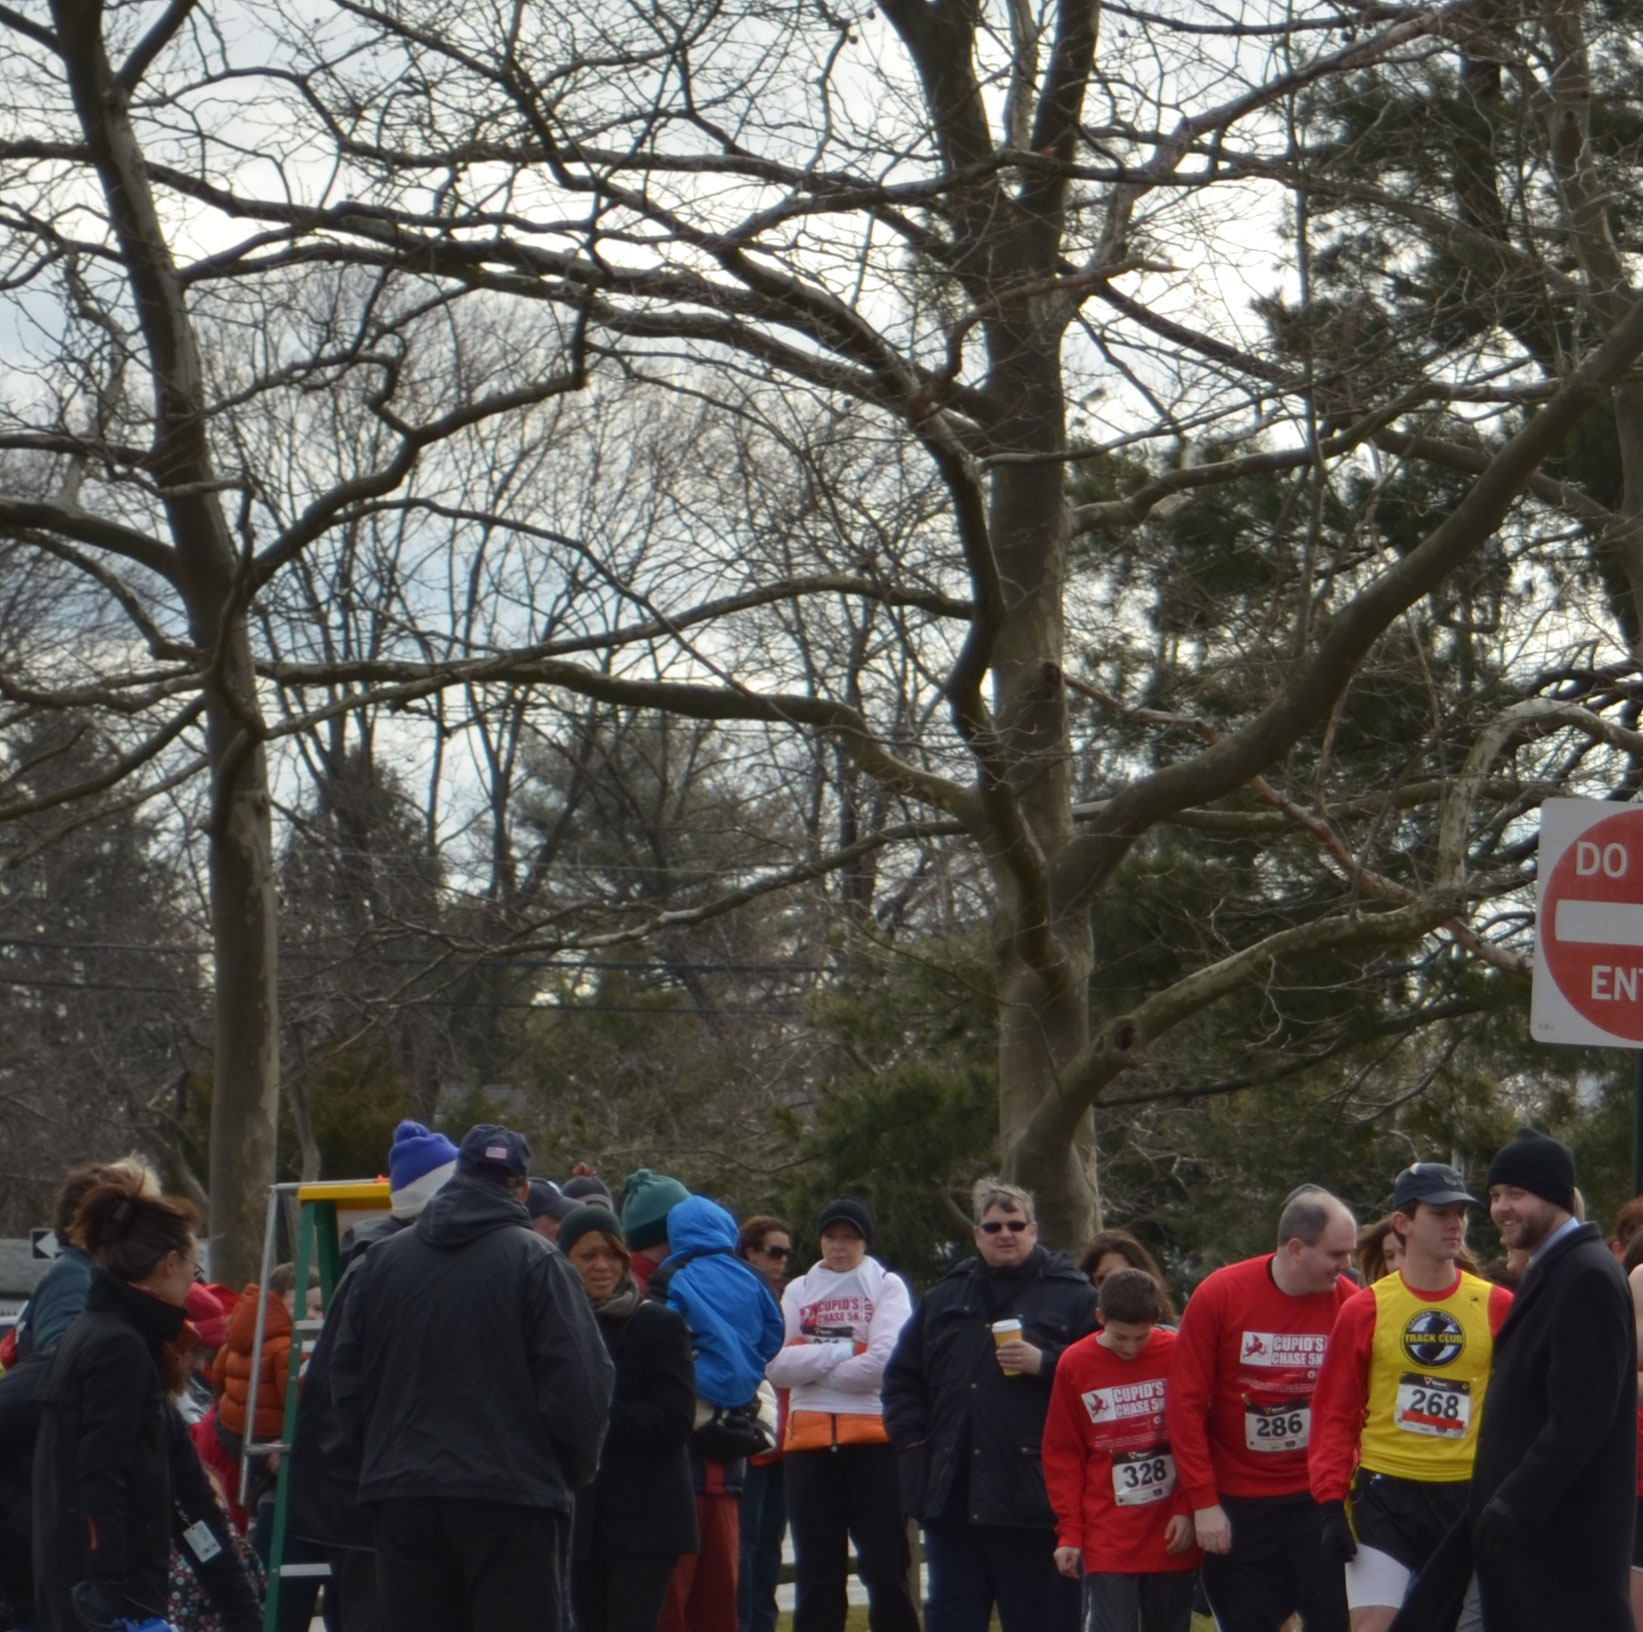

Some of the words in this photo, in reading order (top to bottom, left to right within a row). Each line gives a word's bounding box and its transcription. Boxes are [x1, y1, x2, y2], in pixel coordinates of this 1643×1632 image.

[1575, 841, 1628, 878] DO
[1273, 1335, 1325, 1352] CUPID'S
[1405, 1333, 1436, 1343] TRACK
[1438, 1333, 1463, 1344] CLUB
[1271, 1352, 1306, 1366] CHASE
[1112, 1380, 1165, 1405] CUPID'S
[1408, 1389, 1459, 1419] 268
[1115, 1399, 1150, 1418] CHASE
[1256, 1412, 1303, 1438] 286
[1122, 1458, 1168, 1489] 328
